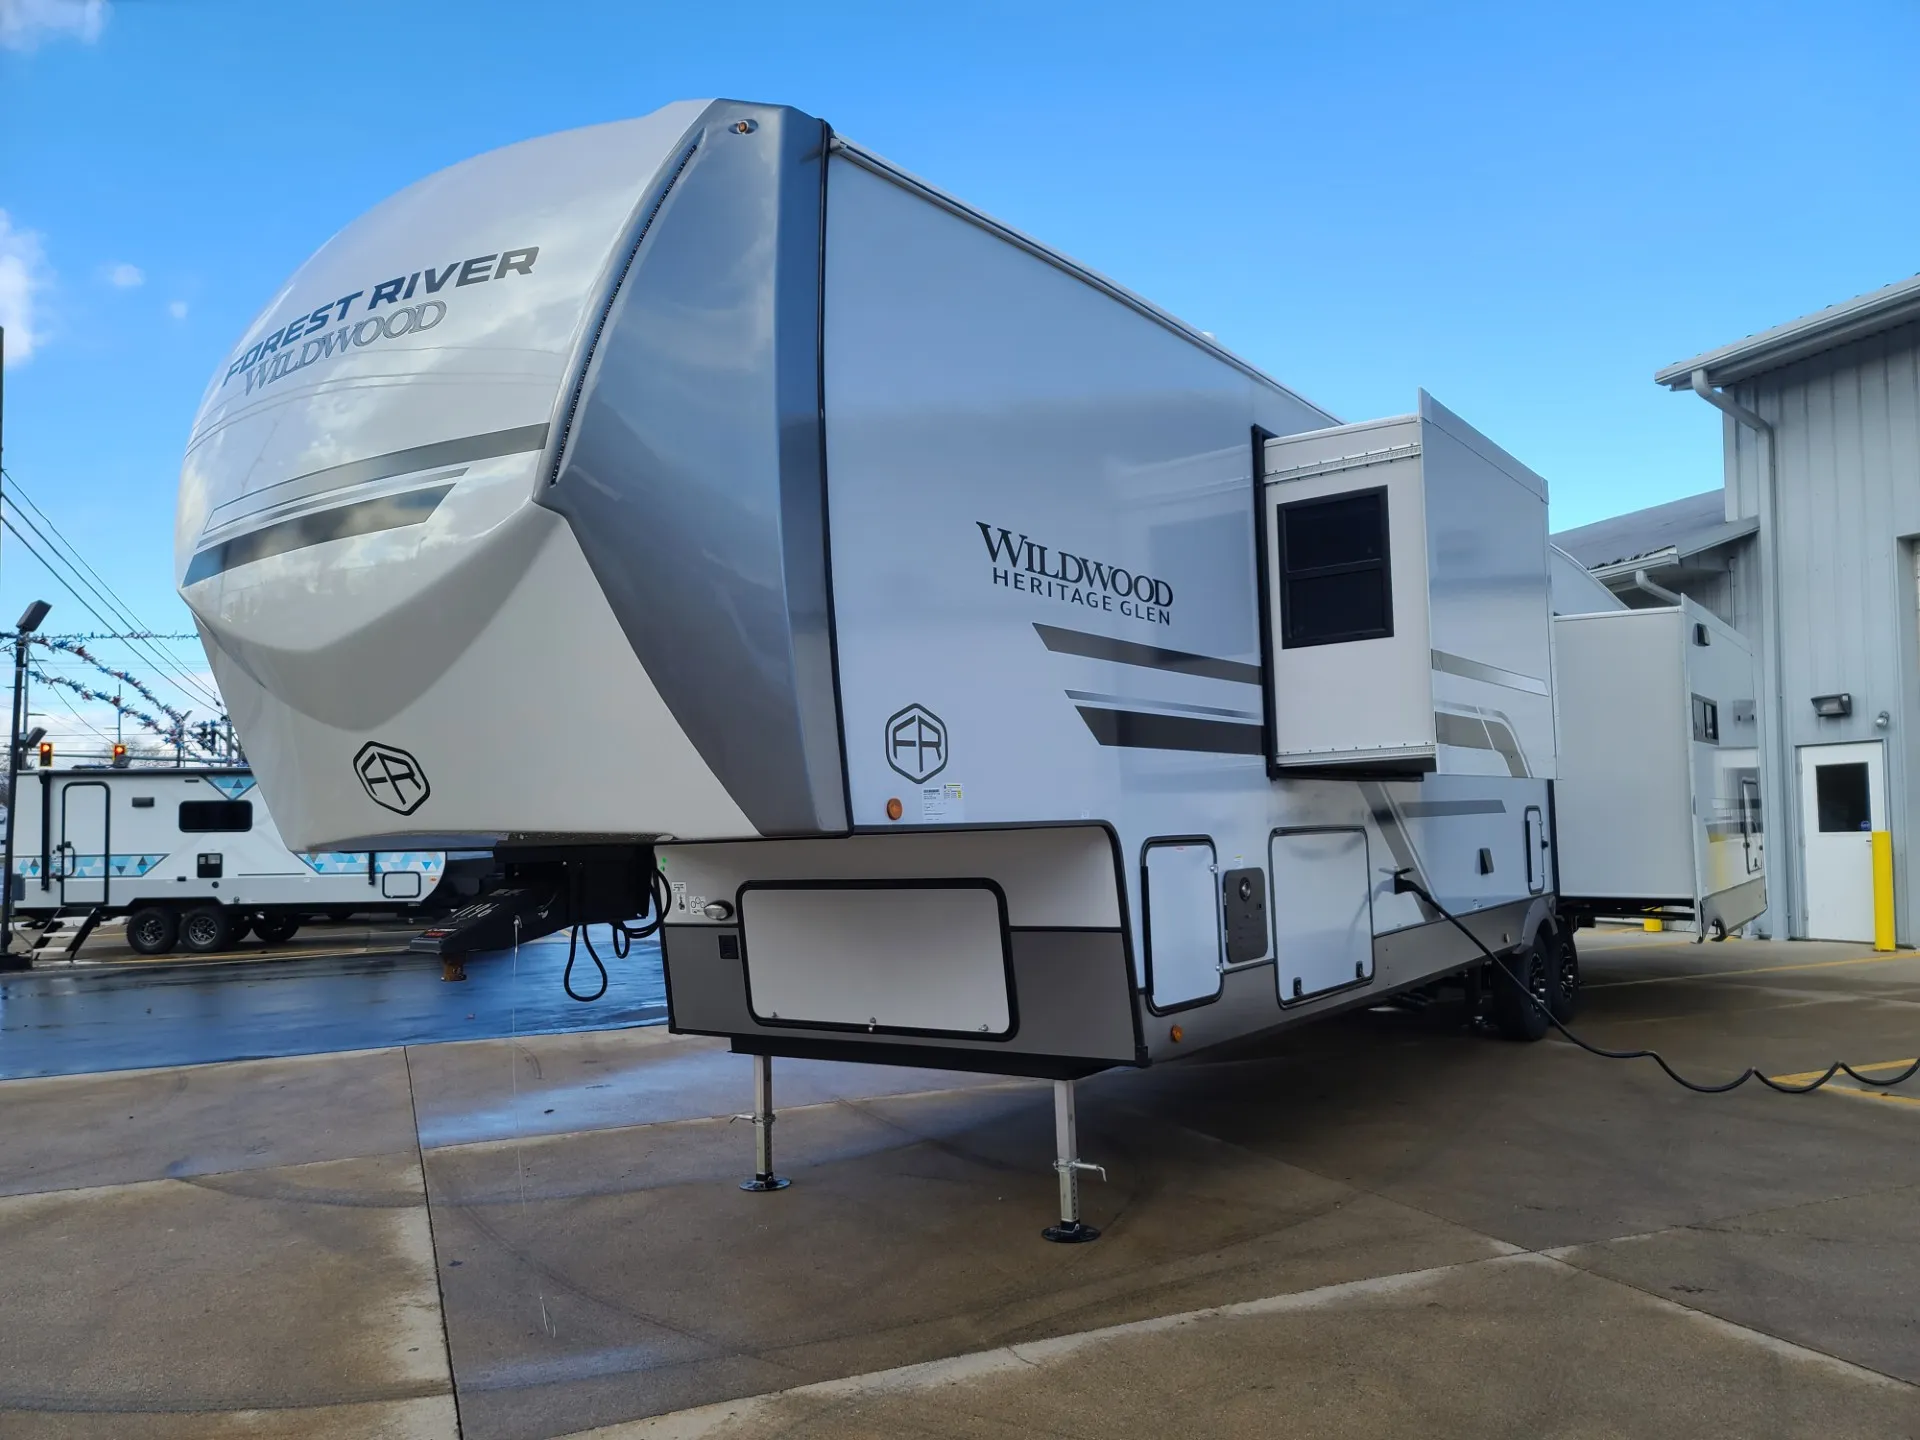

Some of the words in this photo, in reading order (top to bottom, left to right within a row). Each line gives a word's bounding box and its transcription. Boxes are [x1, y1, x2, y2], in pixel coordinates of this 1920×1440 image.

[222, 290, 364, 388] FOREST
[367, 246, 540, 311] RIVER
[245, 300, 448, 396] WILDWOOD
[975, 521, 1174, 607] WILDWOOD
[993, 567, 1112, 612] HERITAGE
[1120, 600, 1171, 626] GLEN
